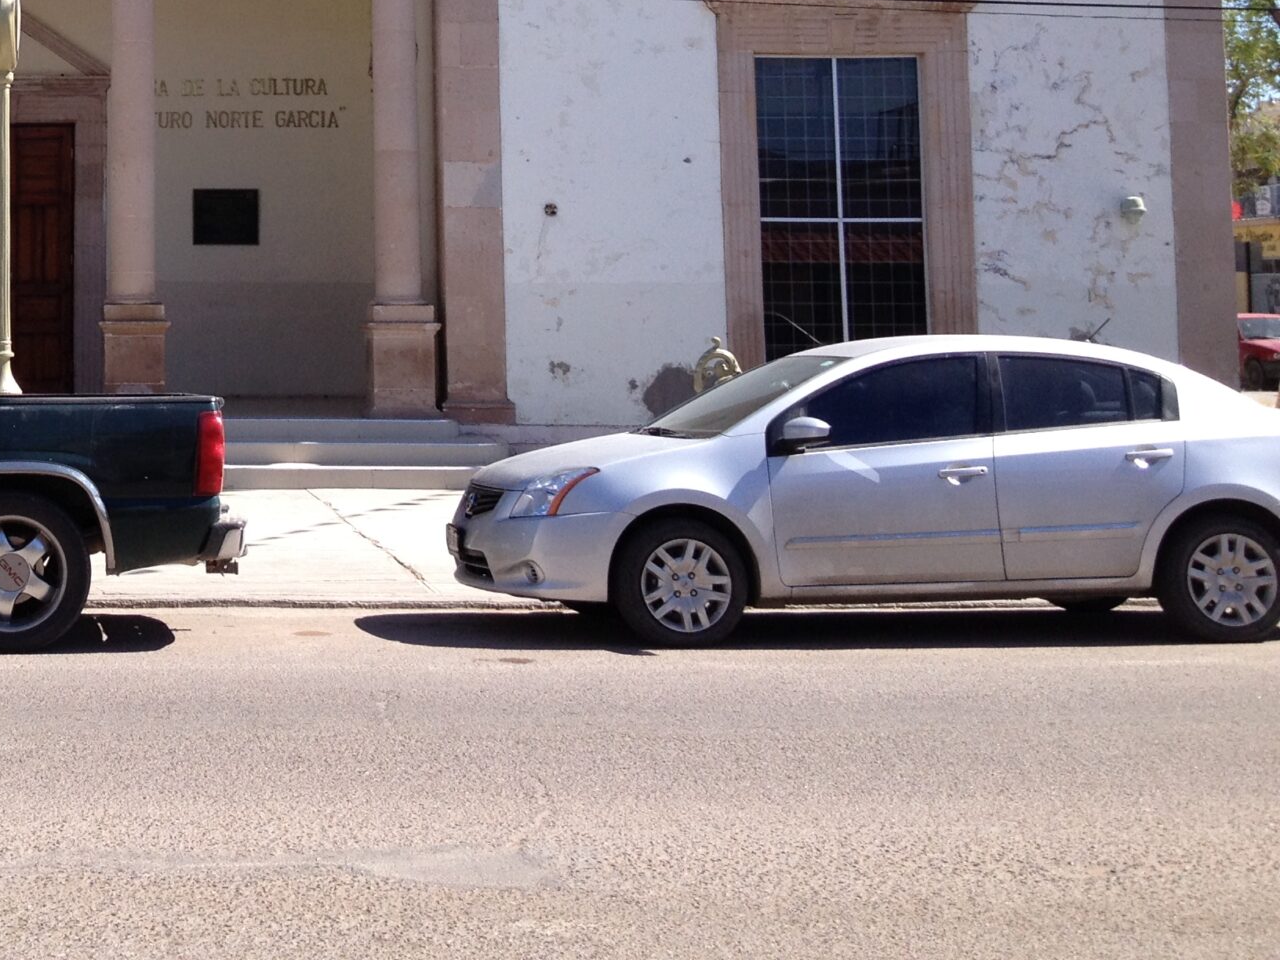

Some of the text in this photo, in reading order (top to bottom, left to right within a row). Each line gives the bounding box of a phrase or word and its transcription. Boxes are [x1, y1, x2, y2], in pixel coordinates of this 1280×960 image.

[181, 79, 204, 96] DE
[217, 79, 240, 96] LA
[250, 78, 328, 96] CULTURA
[205, 111, 263, 128] NORTE
[0, 559, 24, 587] GMC
